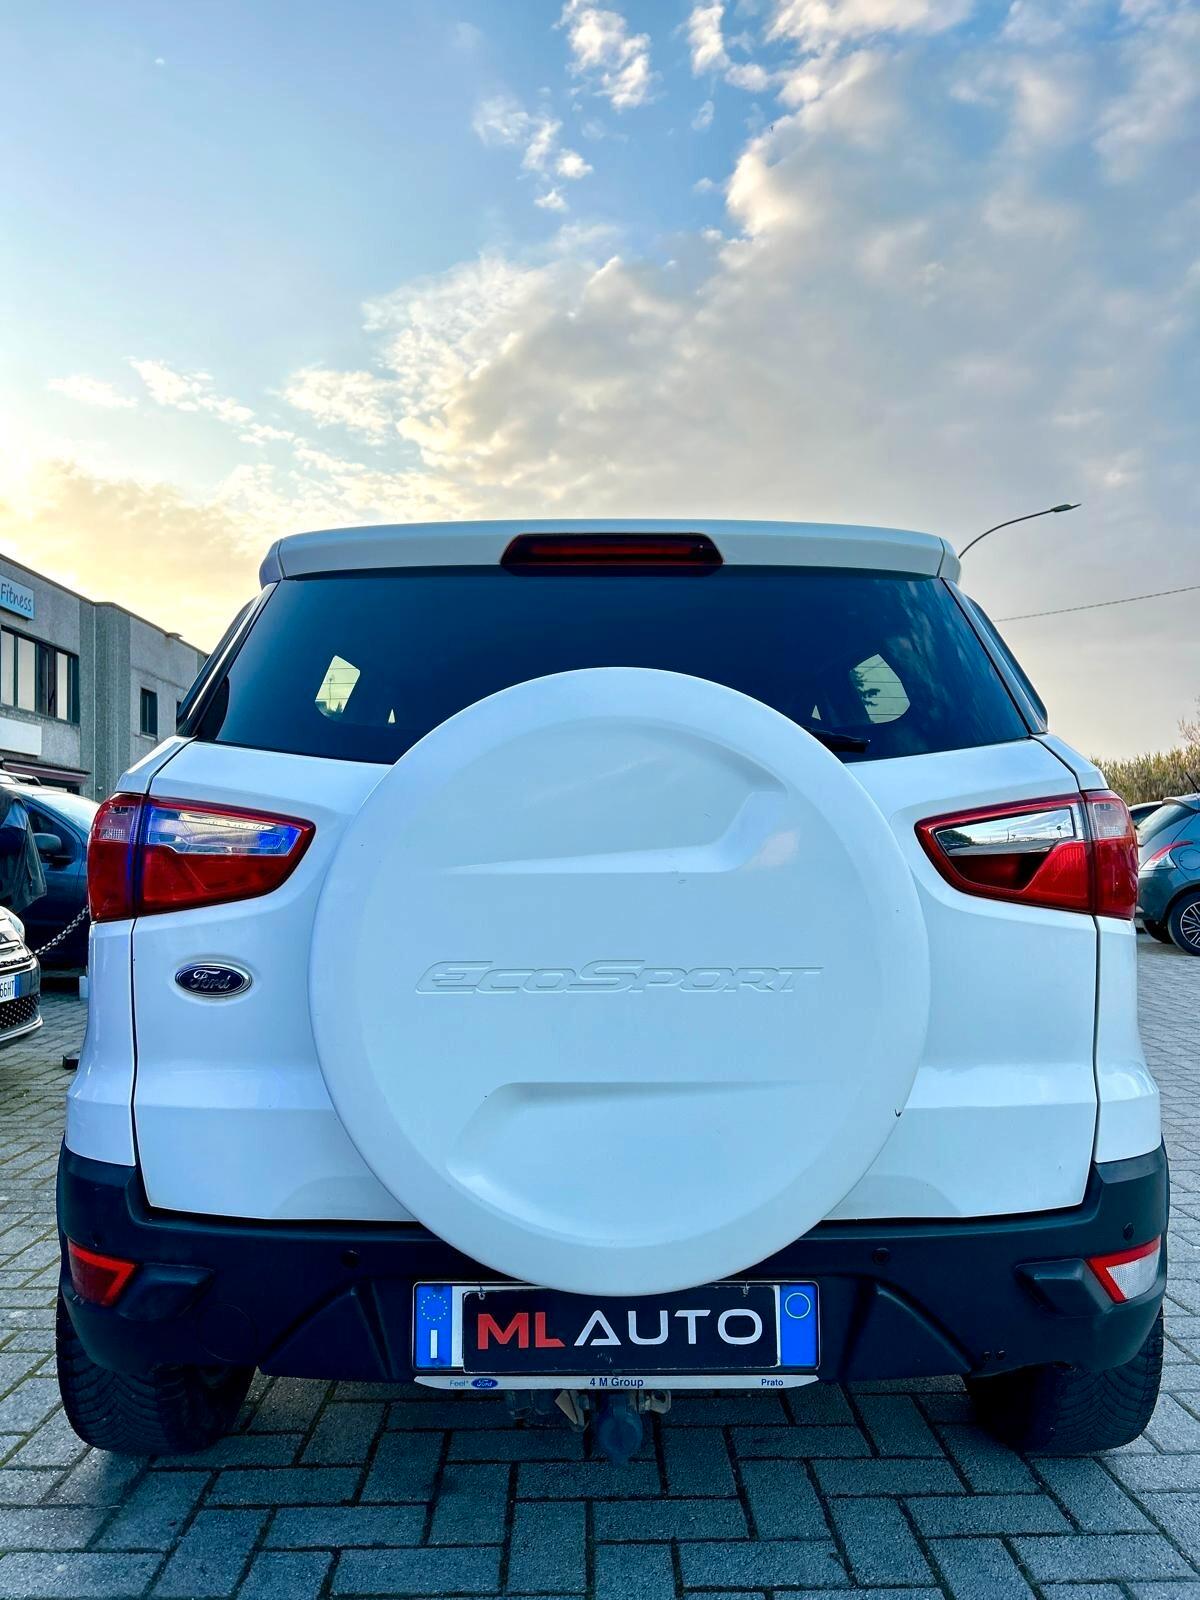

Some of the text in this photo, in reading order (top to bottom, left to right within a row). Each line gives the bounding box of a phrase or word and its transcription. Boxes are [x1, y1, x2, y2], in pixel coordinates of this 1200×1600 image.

[0, 583, 32, 612] Fitness
[190, 969, 231, 989] Ford
[430, 1329, 438, 1359] I
[589, 1377, 596, 1387] 4
[599, 1377, 608, 1387] M
[611, 1377, 644, 1389] Group
[761, 1378, 784, 1387] Prato
